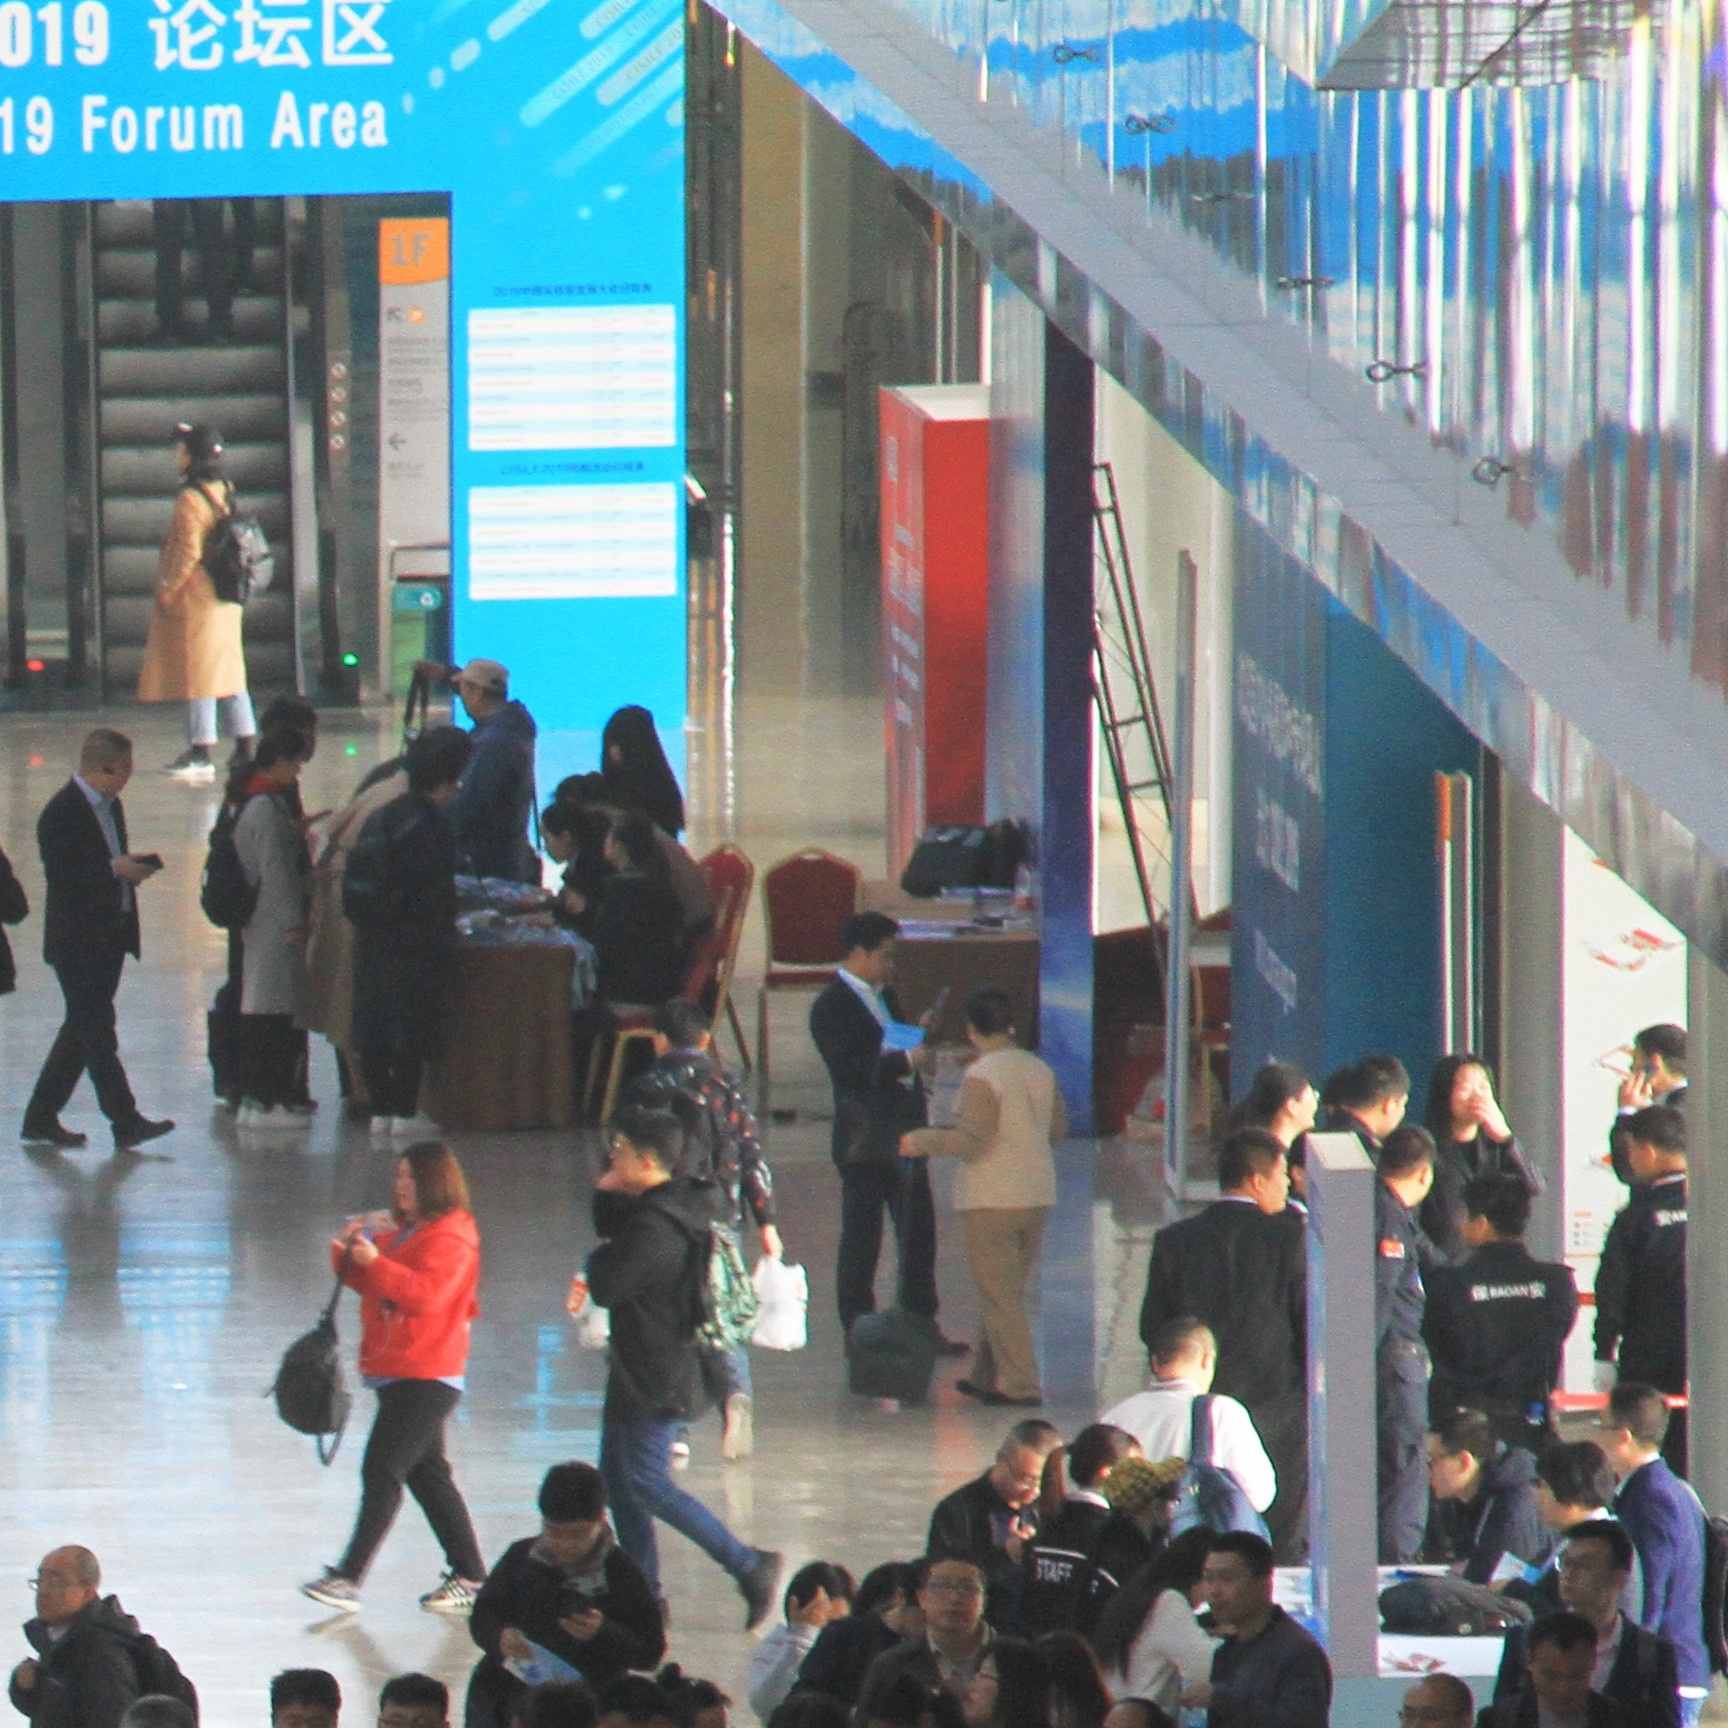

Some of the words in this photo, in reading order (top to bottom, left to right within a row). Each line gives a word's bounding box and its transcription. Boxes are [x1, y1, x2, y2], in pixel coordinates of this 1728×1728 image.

[148, 0, 394, 71] 论坛区
[82, 94, 244, 153] Forum
[270, 91, 389, 149] Area
[387, 231, 432, 268] 1F
